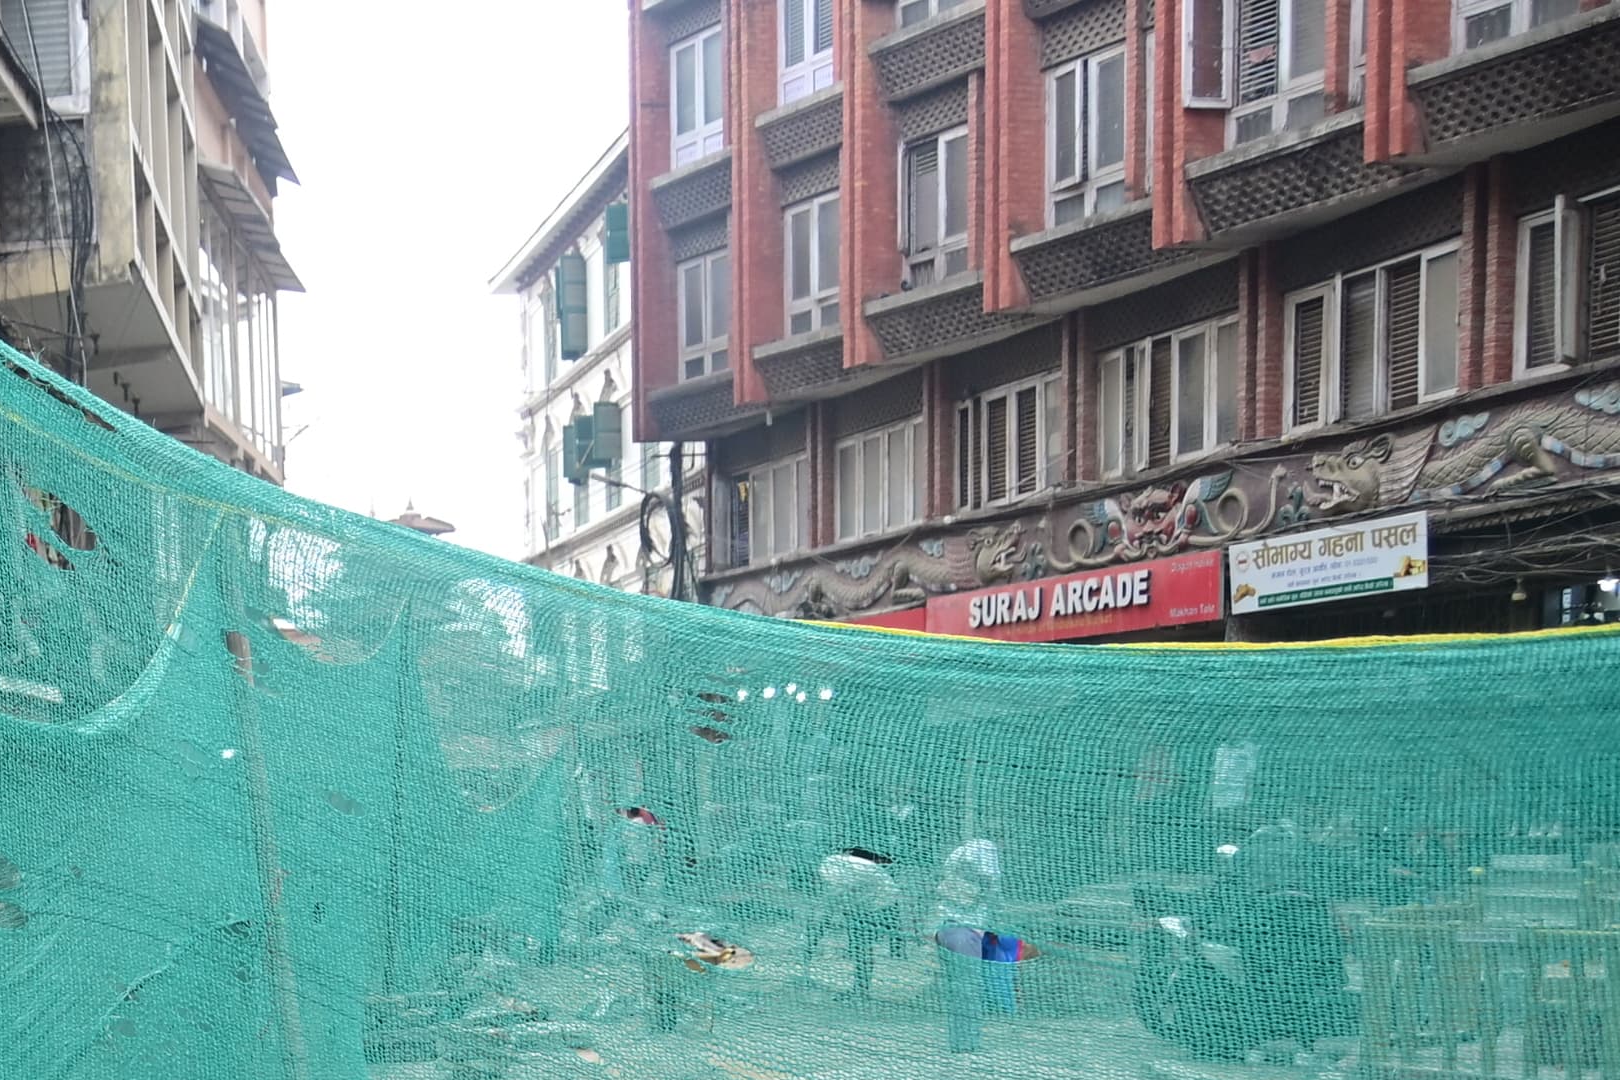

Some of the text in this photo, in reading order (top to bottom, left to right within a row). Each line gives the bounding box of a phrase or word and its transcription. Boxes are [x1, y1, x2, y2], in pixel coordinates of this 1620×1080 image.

[1252, 540, 1314, 571] सौभाग्य
[1318, 531, 1365, 558] गहना
[1371, 522, 1418, 549] पसल
[968, 586, 1043, 629] SURAJ
[1049, 569, 1151, 618] ARCADE
